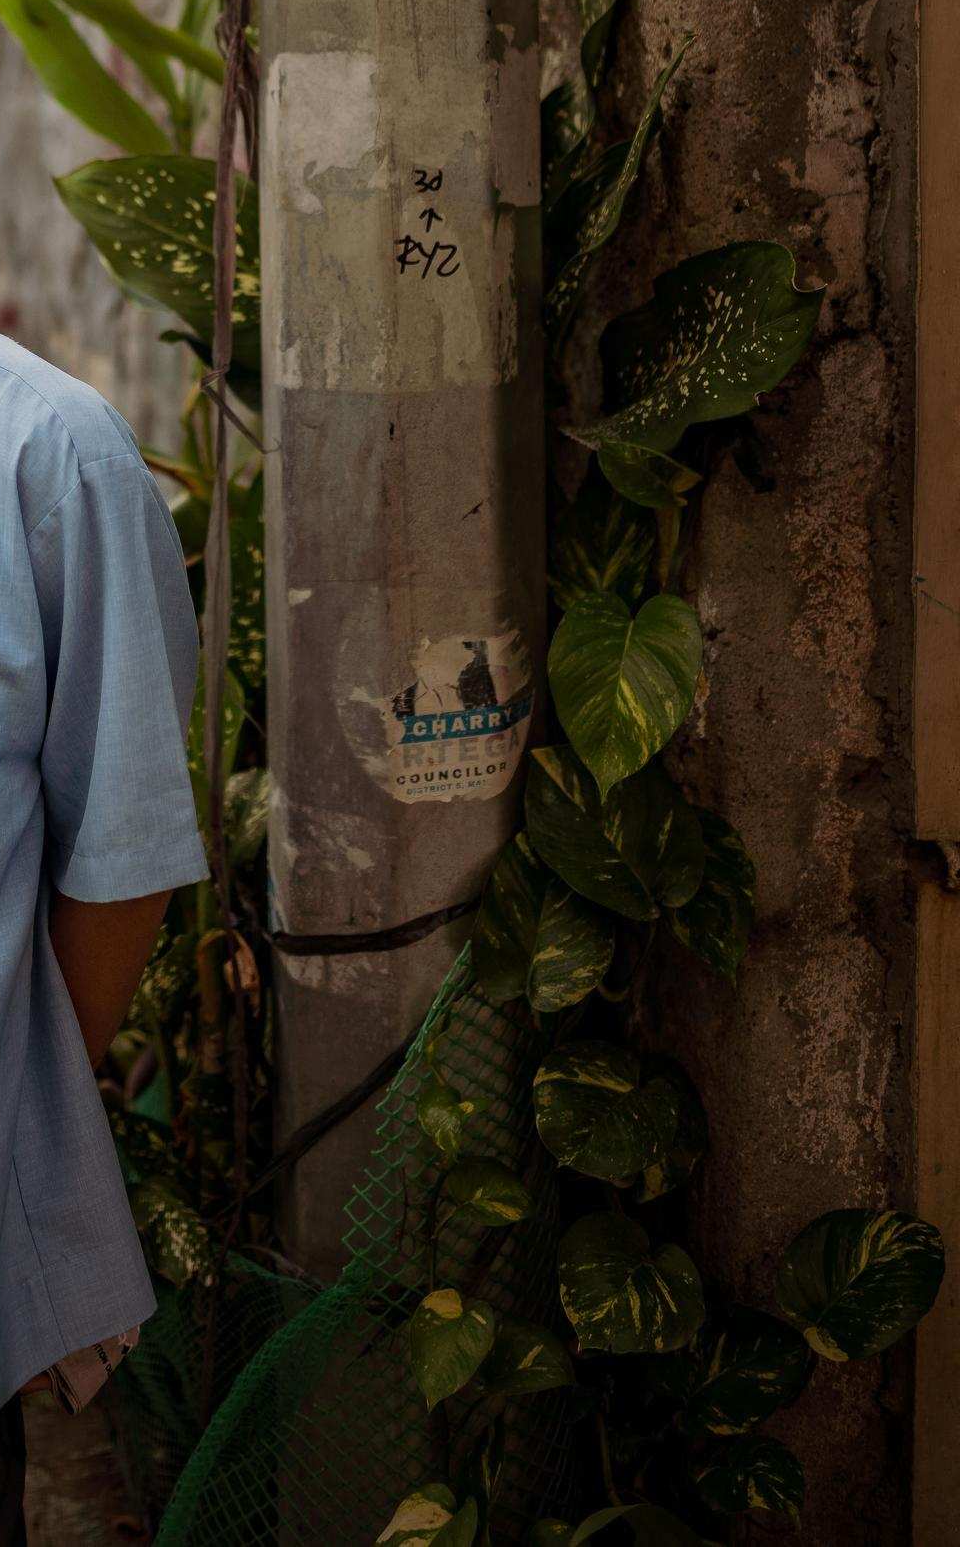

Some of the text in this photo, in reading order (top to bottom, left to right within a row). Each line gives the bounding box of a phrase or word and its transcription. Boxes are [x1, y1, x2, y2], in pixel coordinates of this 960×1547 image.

[413, 708, 512, 737] CHARRY
[404, 730, 519, 767] RTEGA
[396, 762, 507, 785] COUNCILOR
